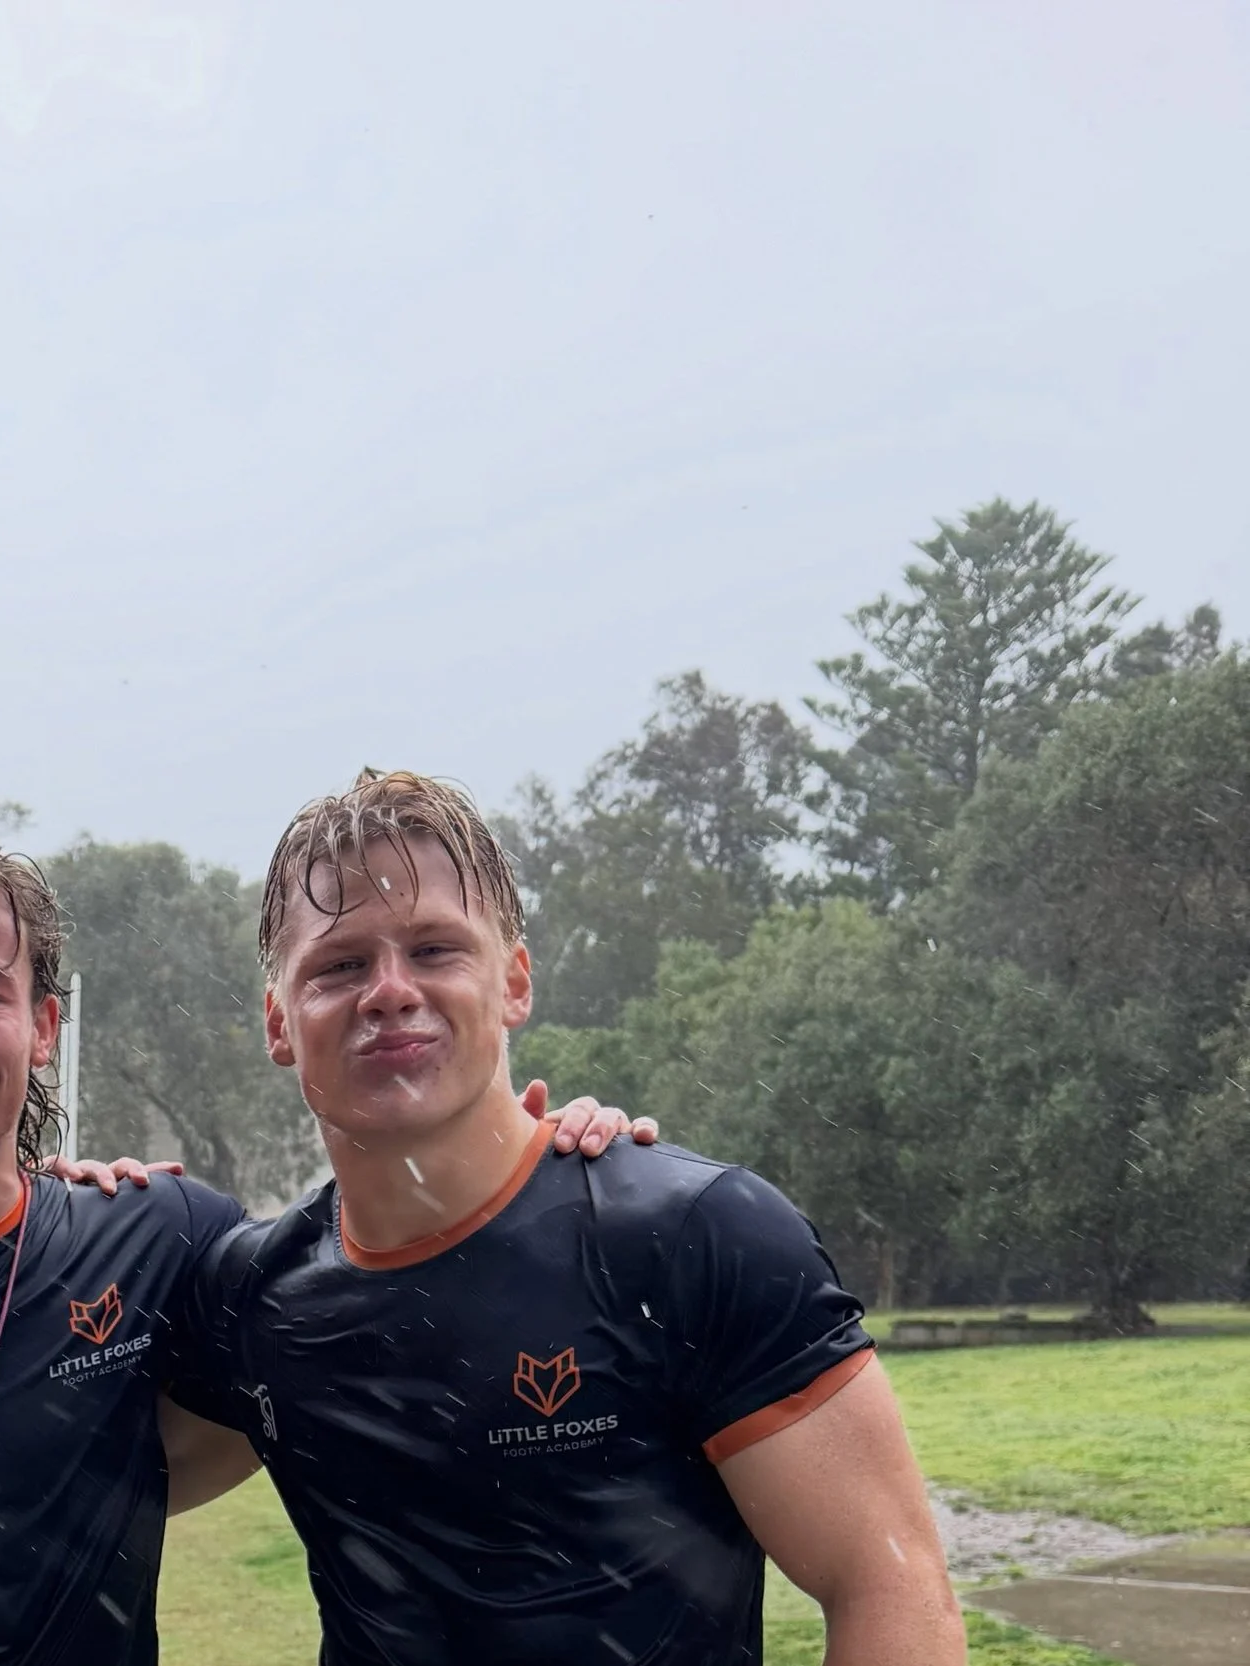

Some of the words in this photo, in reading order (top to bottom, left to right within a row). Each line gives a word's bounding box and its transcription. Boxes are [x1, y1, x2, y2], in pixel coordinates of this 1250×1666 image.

[104, 1333, 152, 1361] FOXES
[62, 1371, 96, 1386] FOOTY
[98, 1354, 142, 1376] ACADEMY
[553, 1414, 618, 1438] FOXES
[503, 1446, 542, 1458] FOOTY
[546, 1436, 605, 1453] ACADEMY
